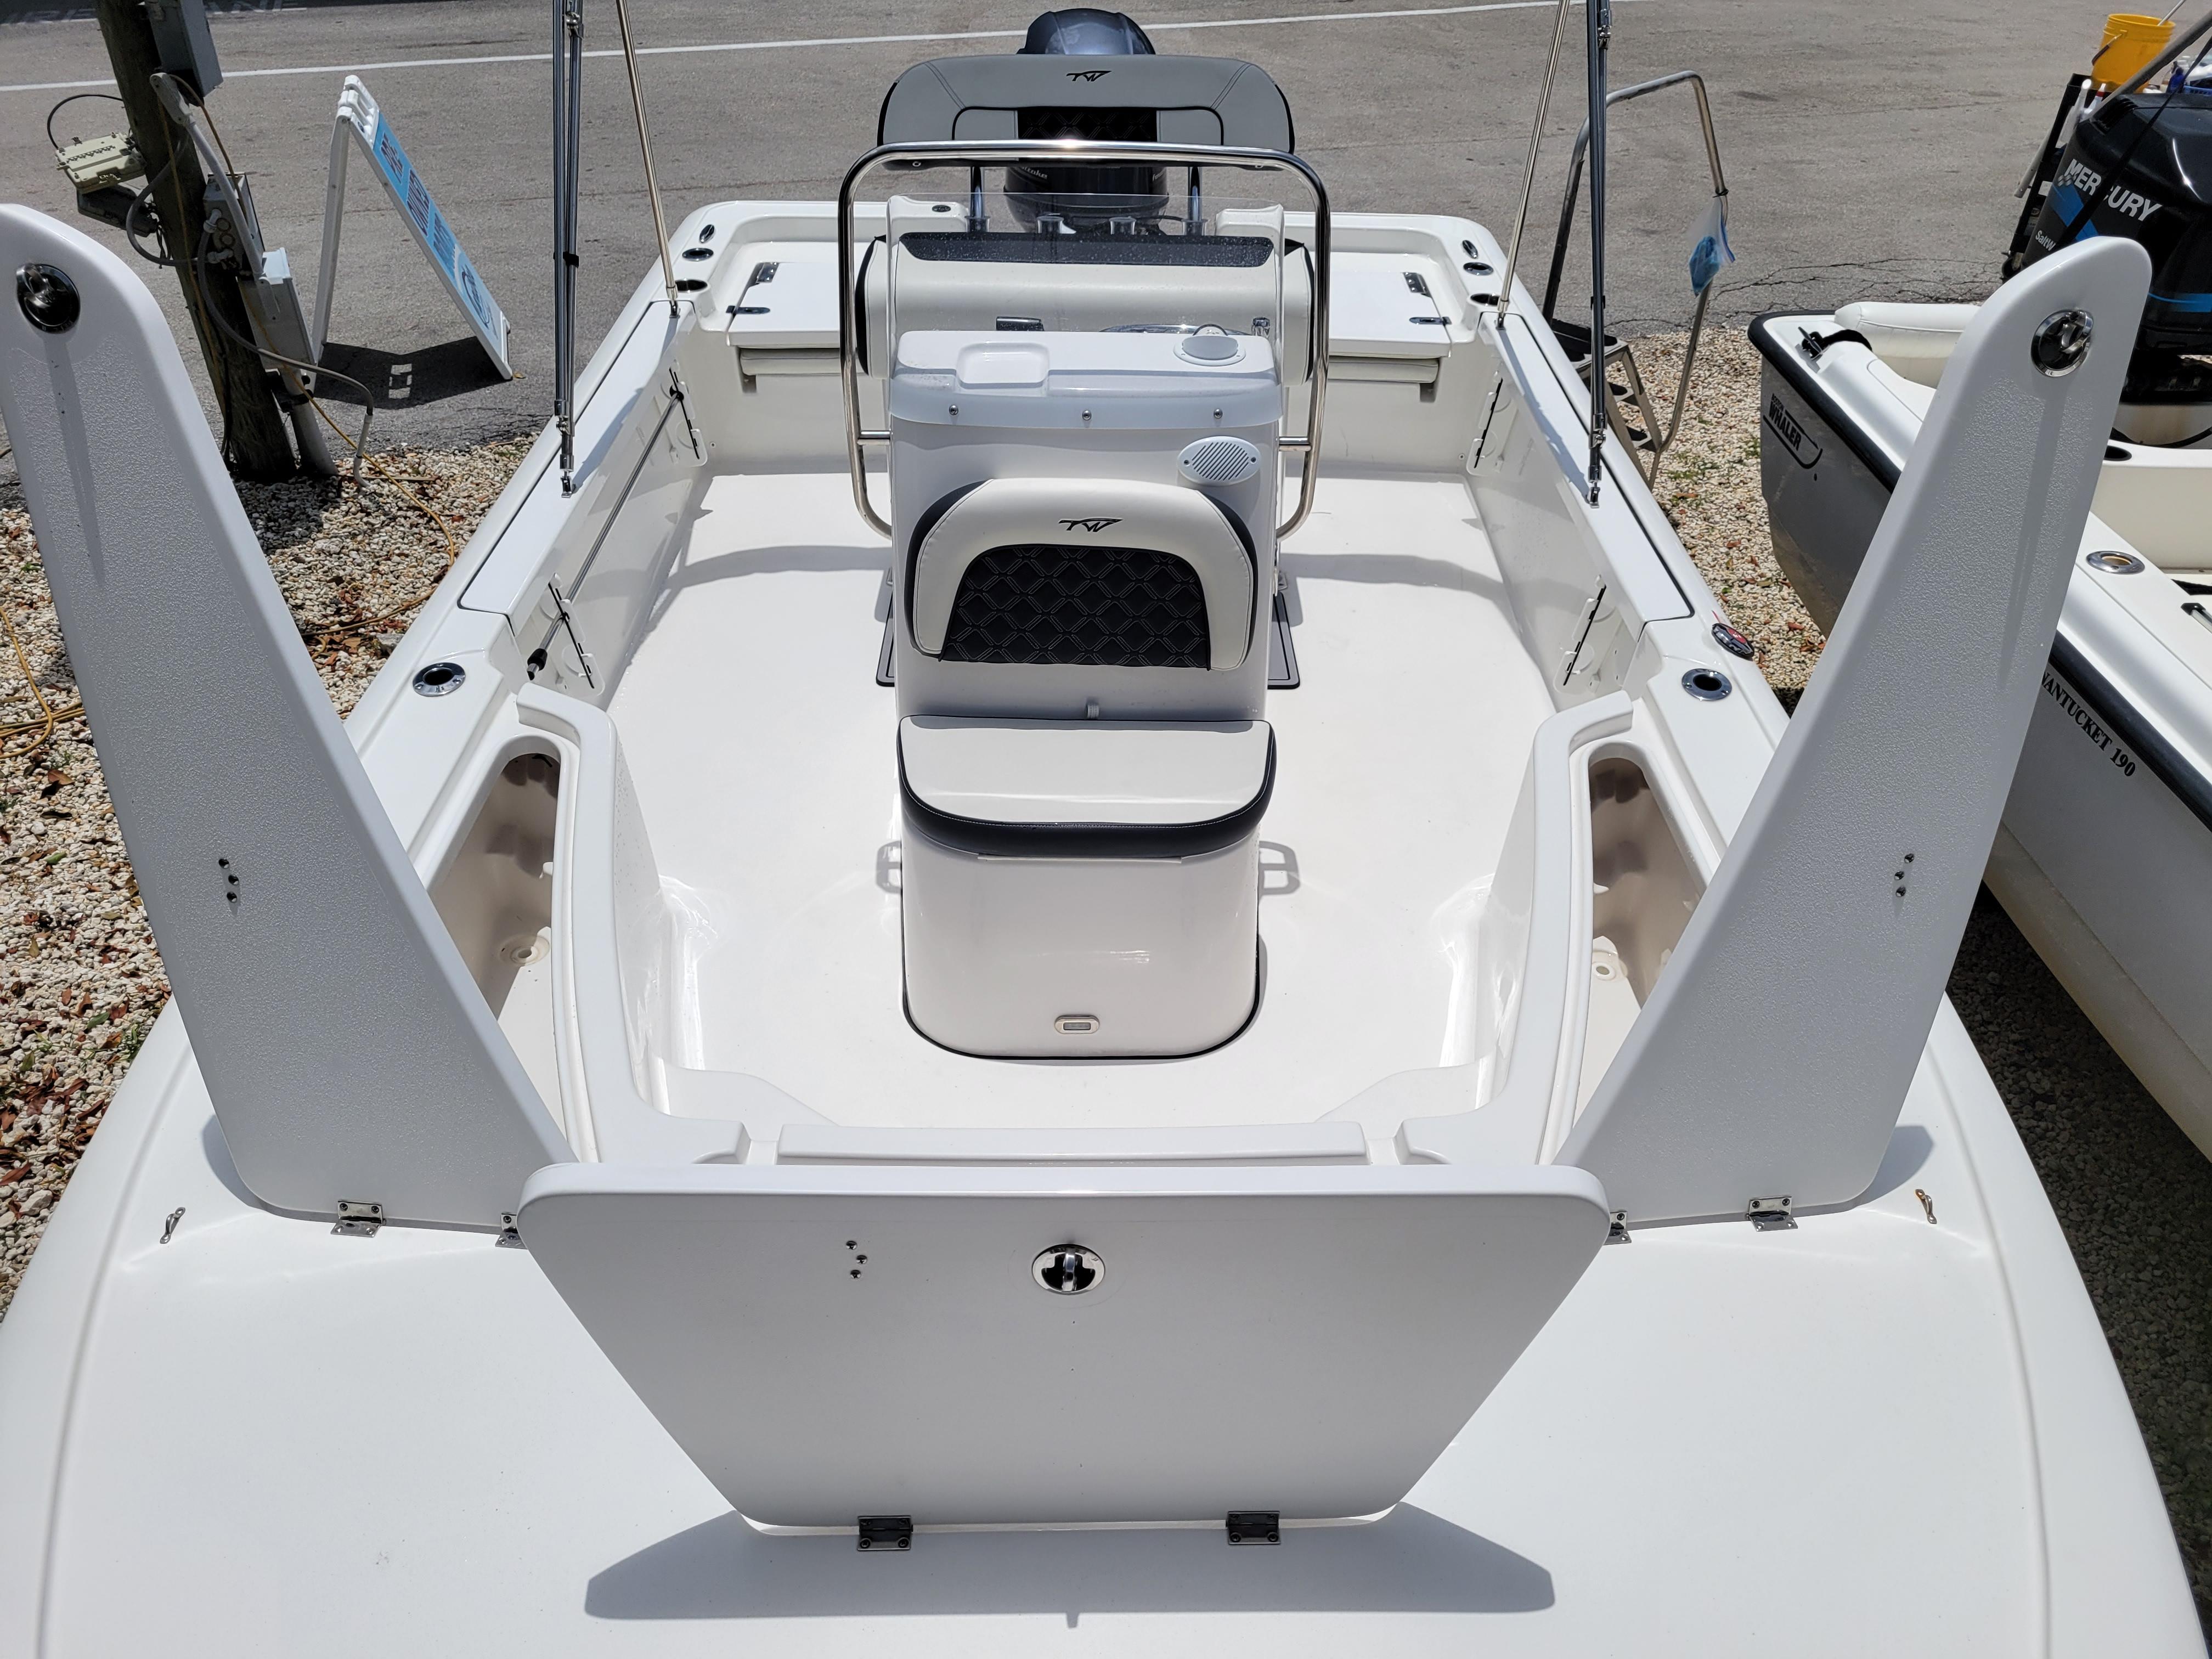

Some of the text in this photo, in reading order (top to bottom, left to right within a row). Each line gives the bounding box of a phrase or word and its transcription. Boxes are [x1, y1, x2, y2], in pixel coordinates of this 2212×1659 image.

[381, 132, 404, 184] PRE
[407, 169, 430, 236] OWNED
[2064, 159, 2163, 222] MERURY
[2035, 230, 2056, 251] SaltW
[1769, 401, 1802, 451] WHALER
[2110, 748, 2136, 776] 190
